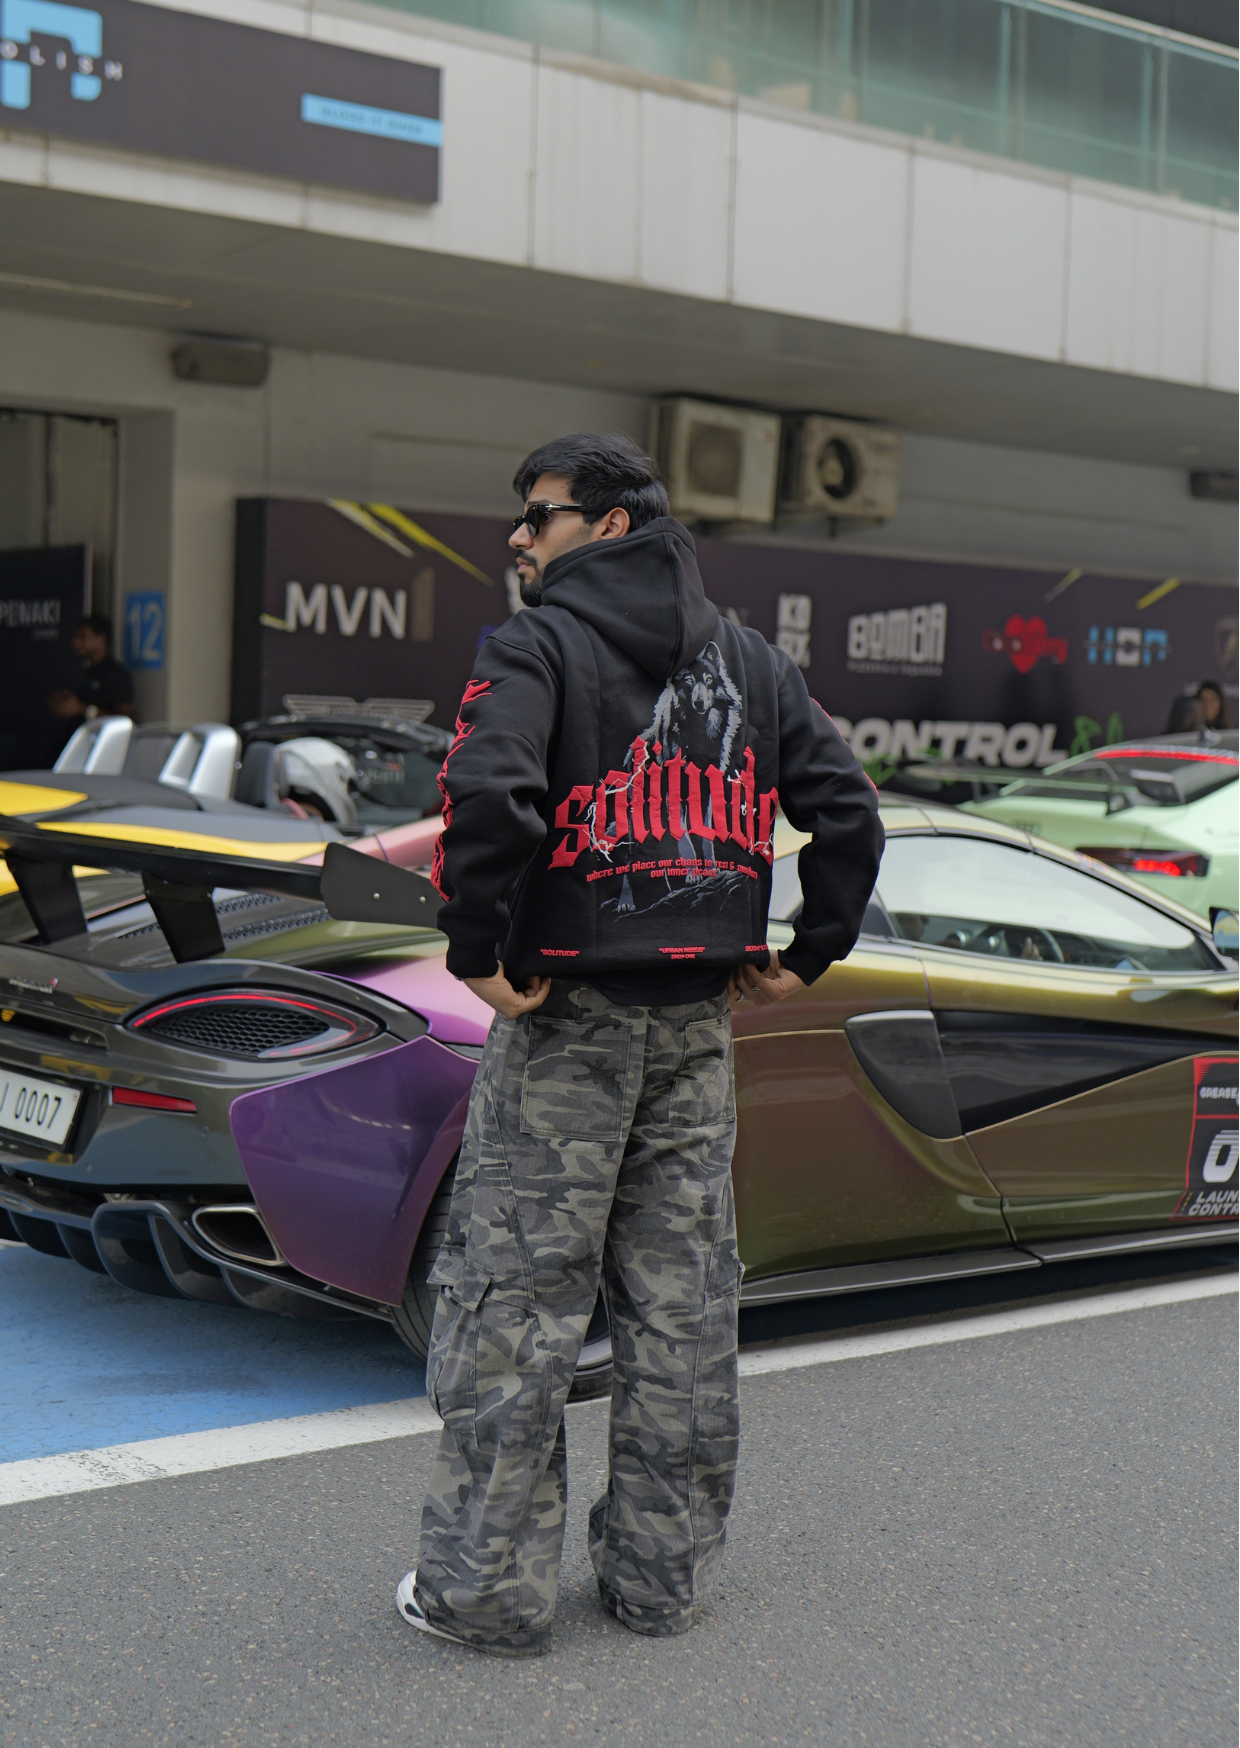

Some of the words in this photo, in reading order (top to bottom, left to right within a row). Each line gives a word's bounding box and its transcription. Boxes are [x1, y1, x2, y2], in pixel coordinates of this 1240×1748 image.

[128, 600, 164, 662] 12
[586, 868, 614, 883] where
[615, 864, 631, 875] we
[631, 860, 657, 873] place
[658, 859, 673, 868] our
[650, 869, 665, 878] our
[667, 867, 690, 877] inner
[692, 868, 718, 878] peace
[14, 1086, 63, 1129] 0007
[1195, 1190, 1239, 1203] LAUN
